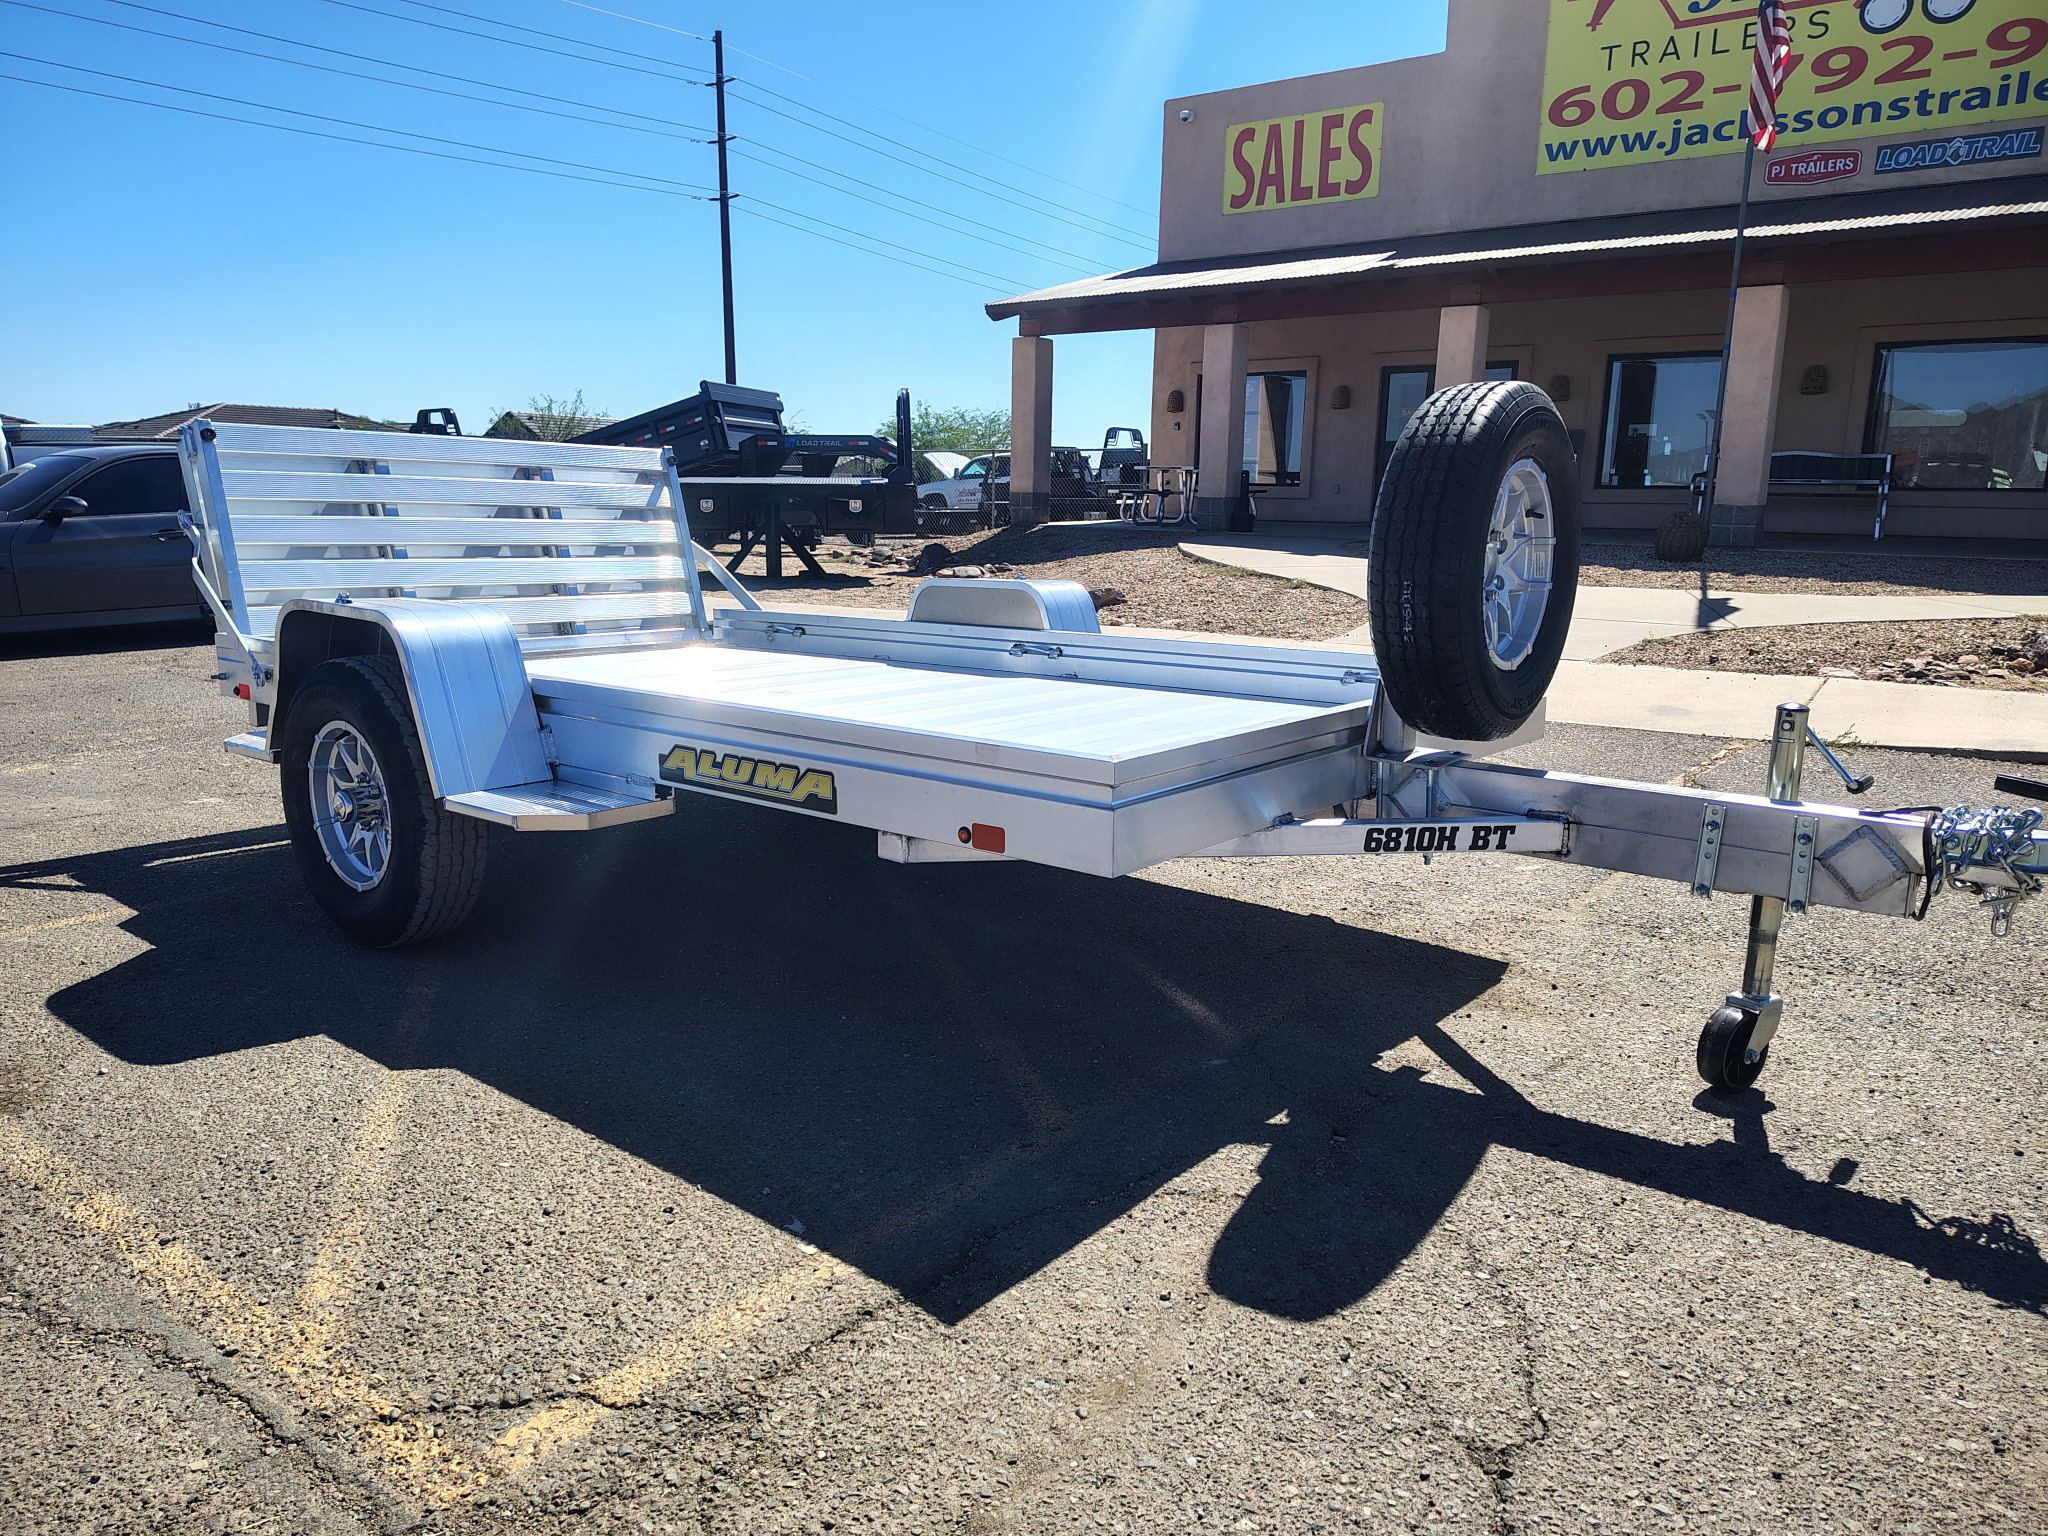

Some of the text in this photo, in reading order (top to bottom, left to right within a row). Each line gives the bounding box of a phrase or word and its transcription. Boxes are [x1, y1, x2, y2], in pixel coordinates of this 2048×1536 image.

[1229, 109, 1374, 209] SALES
[1771, 157, 1854, 178] PJ TRAILERS
[1876, 131, 2041, 171] LOAD TRAIL
[663, 748, 834, 802] ALUMA
[1364, 825, 1516, 852] 6810H BT
